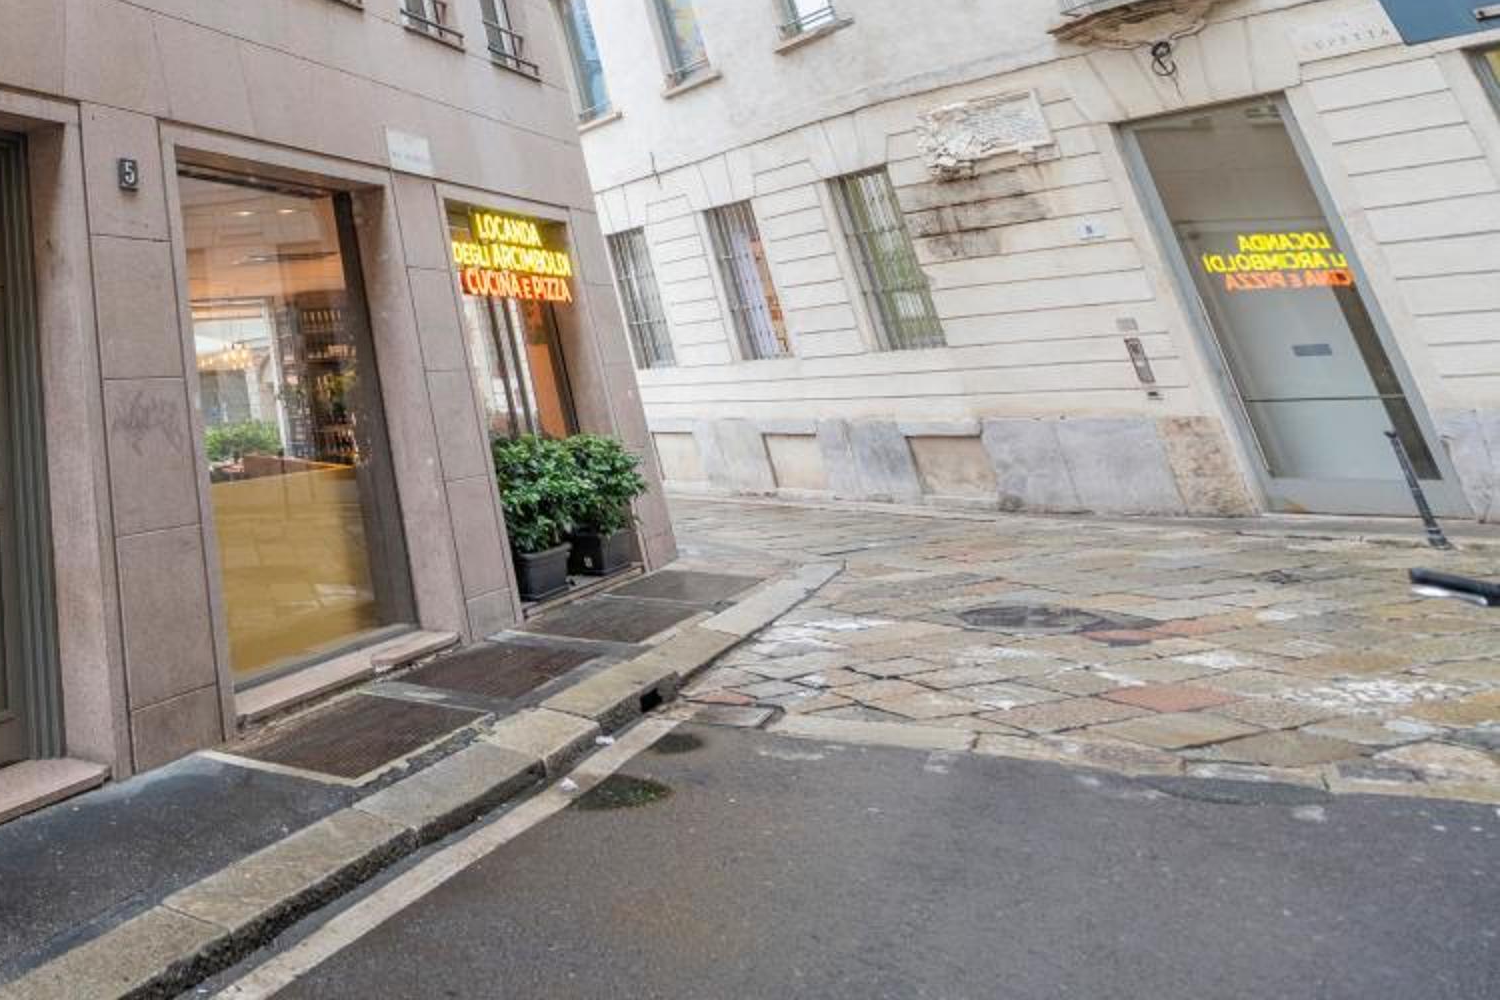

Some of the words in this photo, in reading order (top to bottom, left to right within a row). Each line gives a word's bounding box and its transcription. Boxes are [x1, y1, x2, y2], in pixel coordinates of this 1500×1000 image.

[124, 162, 135, 184] 5
[475, 212, 542, 248] LOCANDA
[452, 241, 491, 267] DEGLI
[491, 243, 572, 276] ARCIMBOLDI
[465, 267, 522, 299] CUCINA
[523, 279, 533, 299] E
[532, 276, 573, 303] PIZZA
